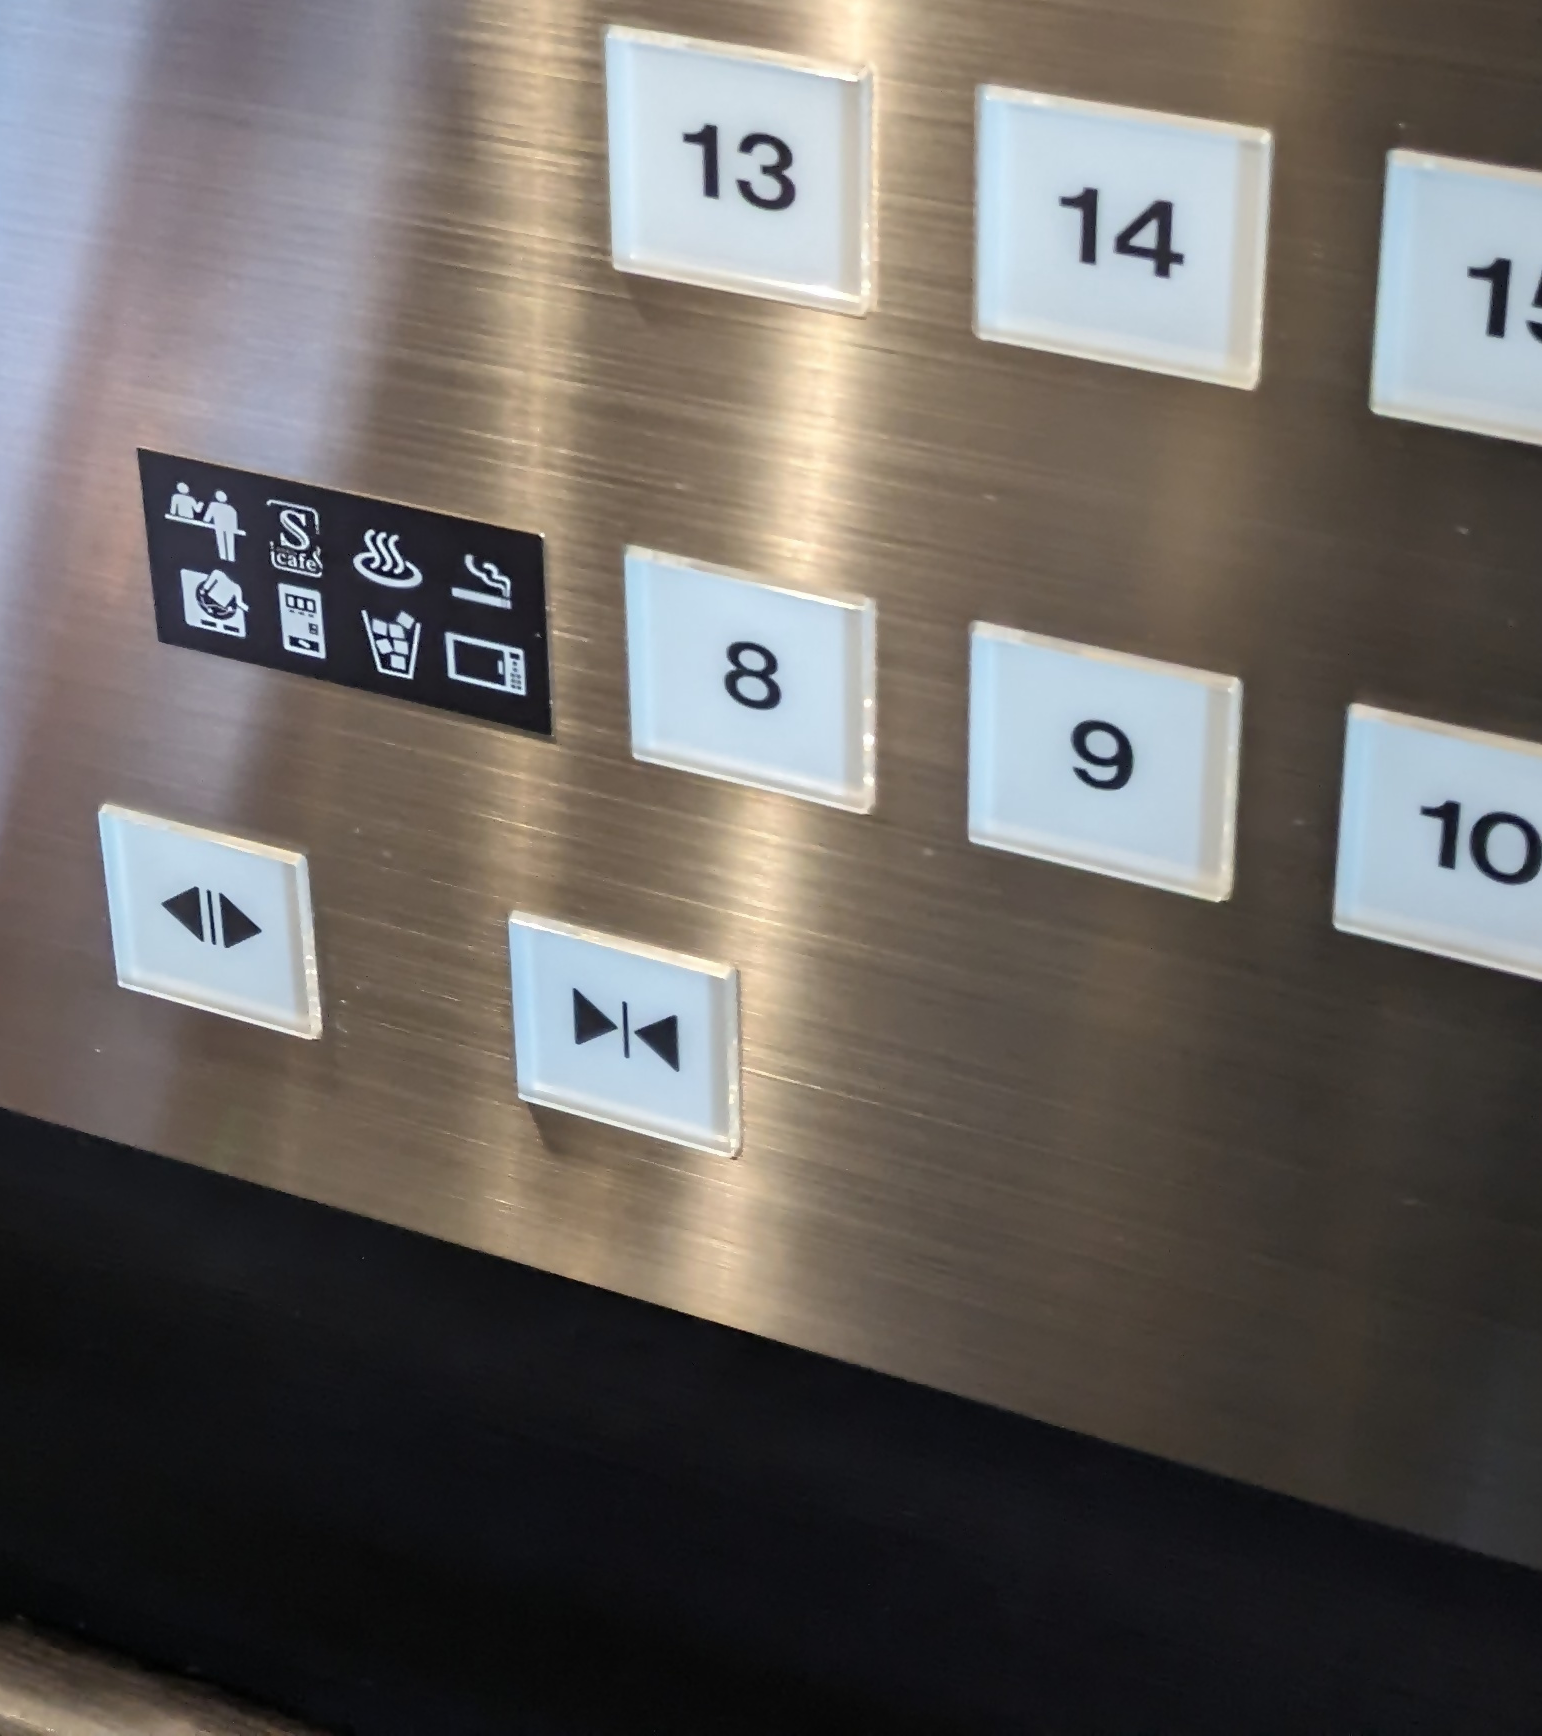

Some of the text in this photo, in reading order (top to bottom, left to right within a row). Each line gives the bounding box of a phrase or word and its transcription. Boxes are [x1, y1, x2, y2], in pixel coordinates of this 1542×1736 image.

[683, 124, 796, 211] 13
[1060, 187, 1185, 278] 14
[280, 510, 310, 550] S
[724, 641, 782, 710] 8
[1071, 719, 1134, 791] 9
